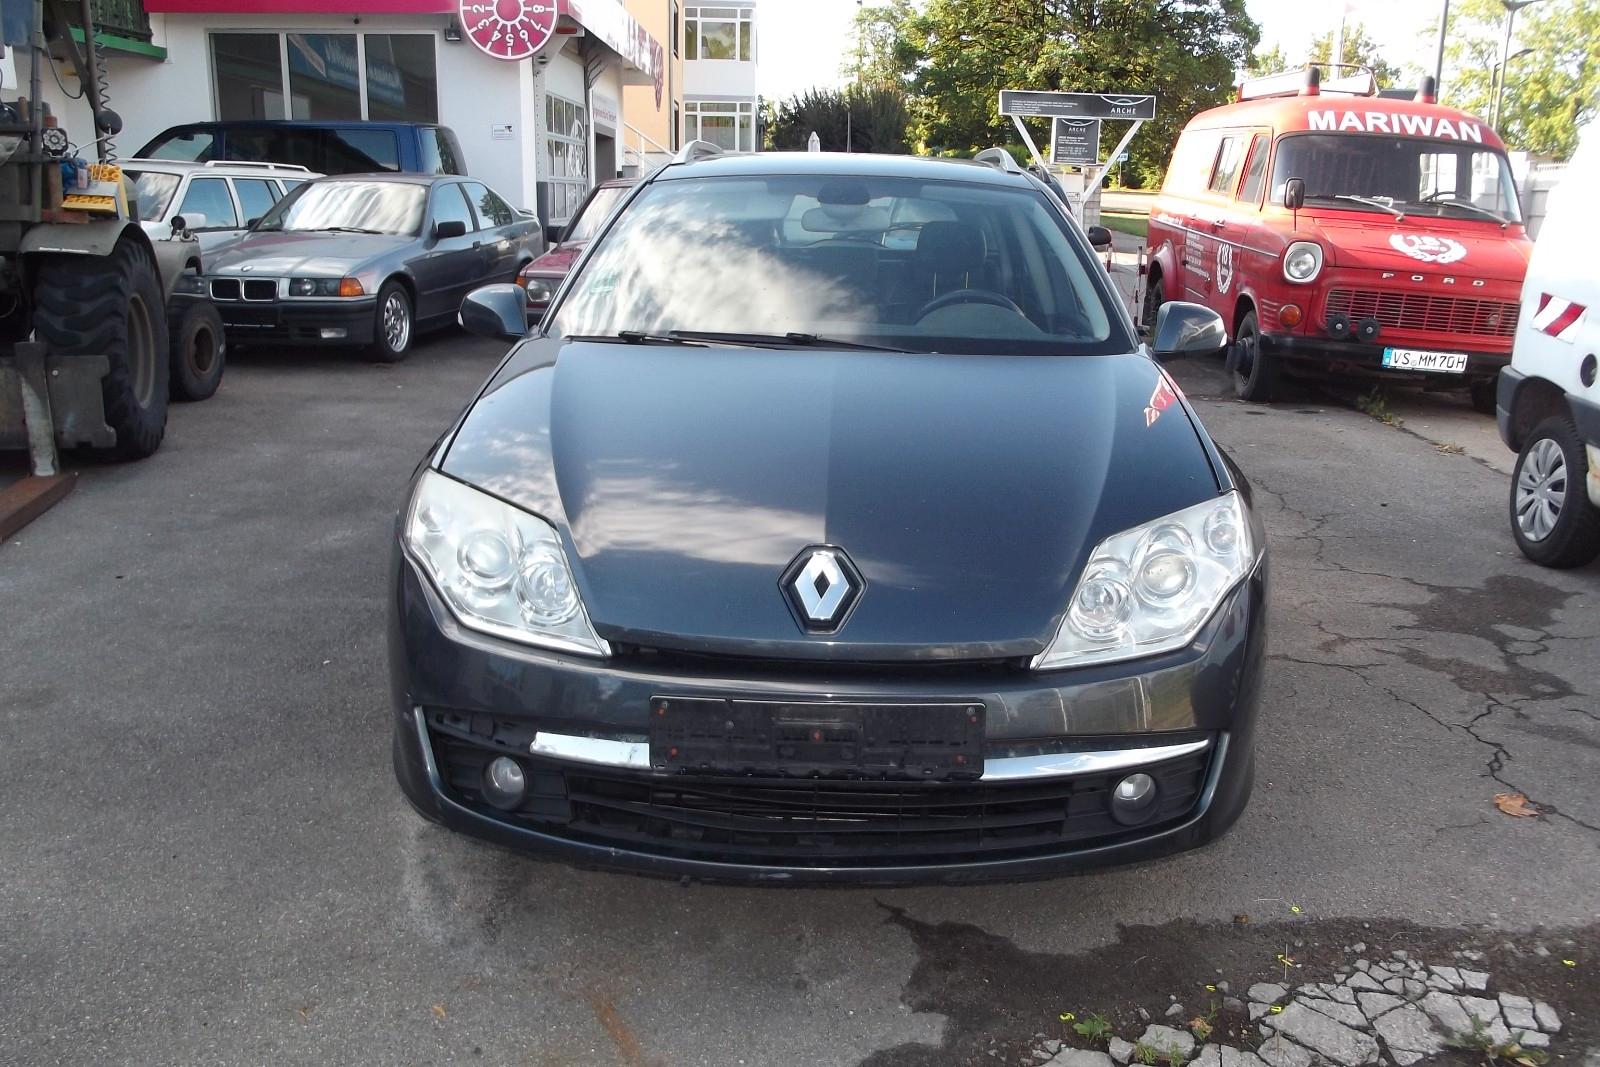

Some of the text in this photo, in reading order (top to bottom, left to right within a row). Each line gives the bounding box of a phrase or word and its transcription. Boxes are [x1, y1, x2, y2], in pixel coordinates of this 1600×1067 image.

[1110, 107, 1137, 115] ARCHE
[1307, 110, 1482, 143] MARIWAN
[1382, 272, 1485, 286] FORD
